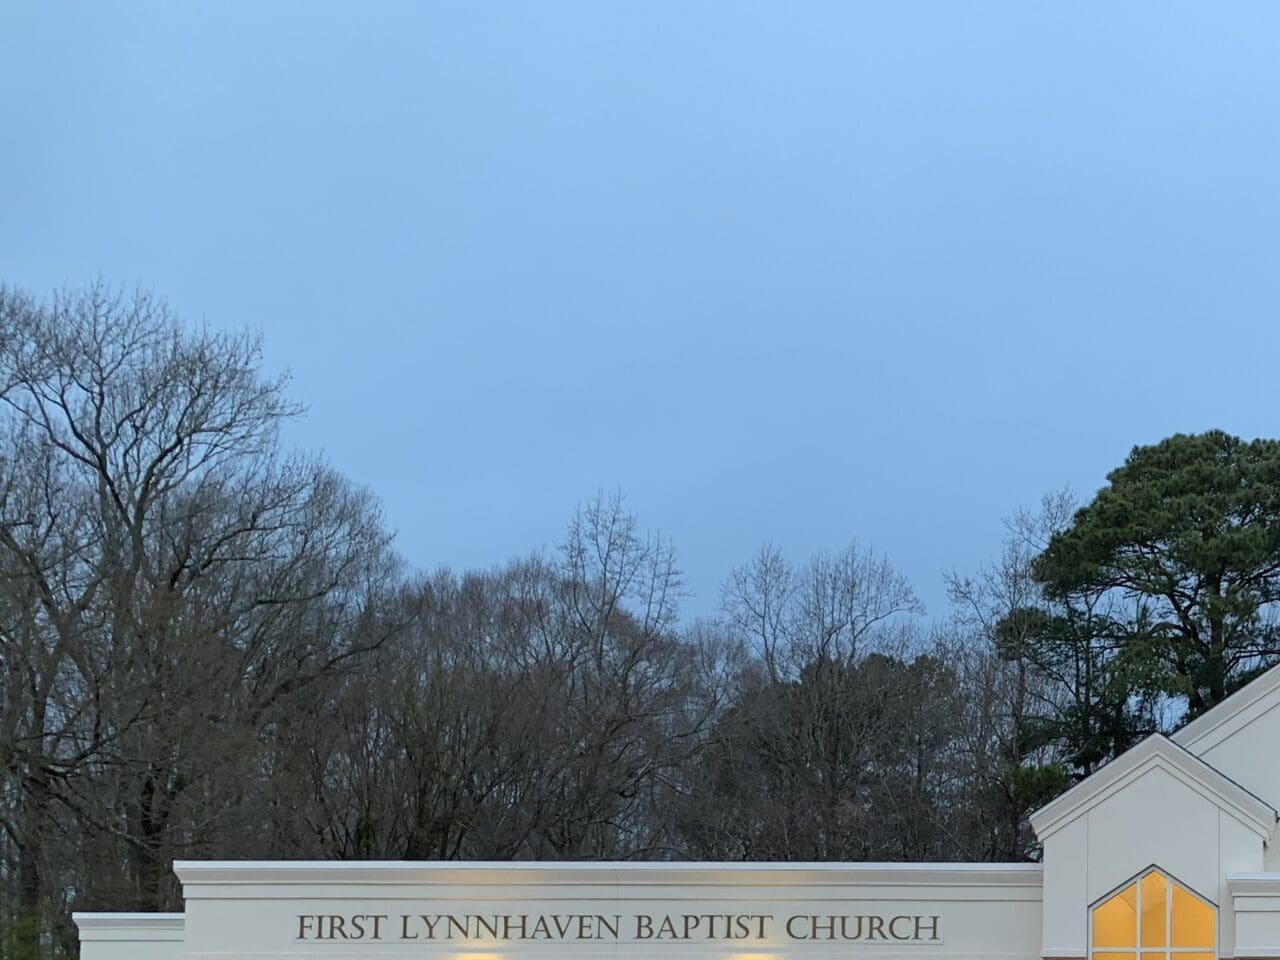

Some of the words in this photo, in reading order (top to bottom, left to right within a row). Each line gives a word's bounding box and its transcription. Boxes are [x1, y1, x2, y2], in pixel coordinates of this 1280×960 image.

[296, 914, 389, 940] FIRST
[399, 914, 622, 940] LYNNHAVEN
[634, 914, 774, 940] BAPTIST
[786, 915, 941, 941] CHURCH
